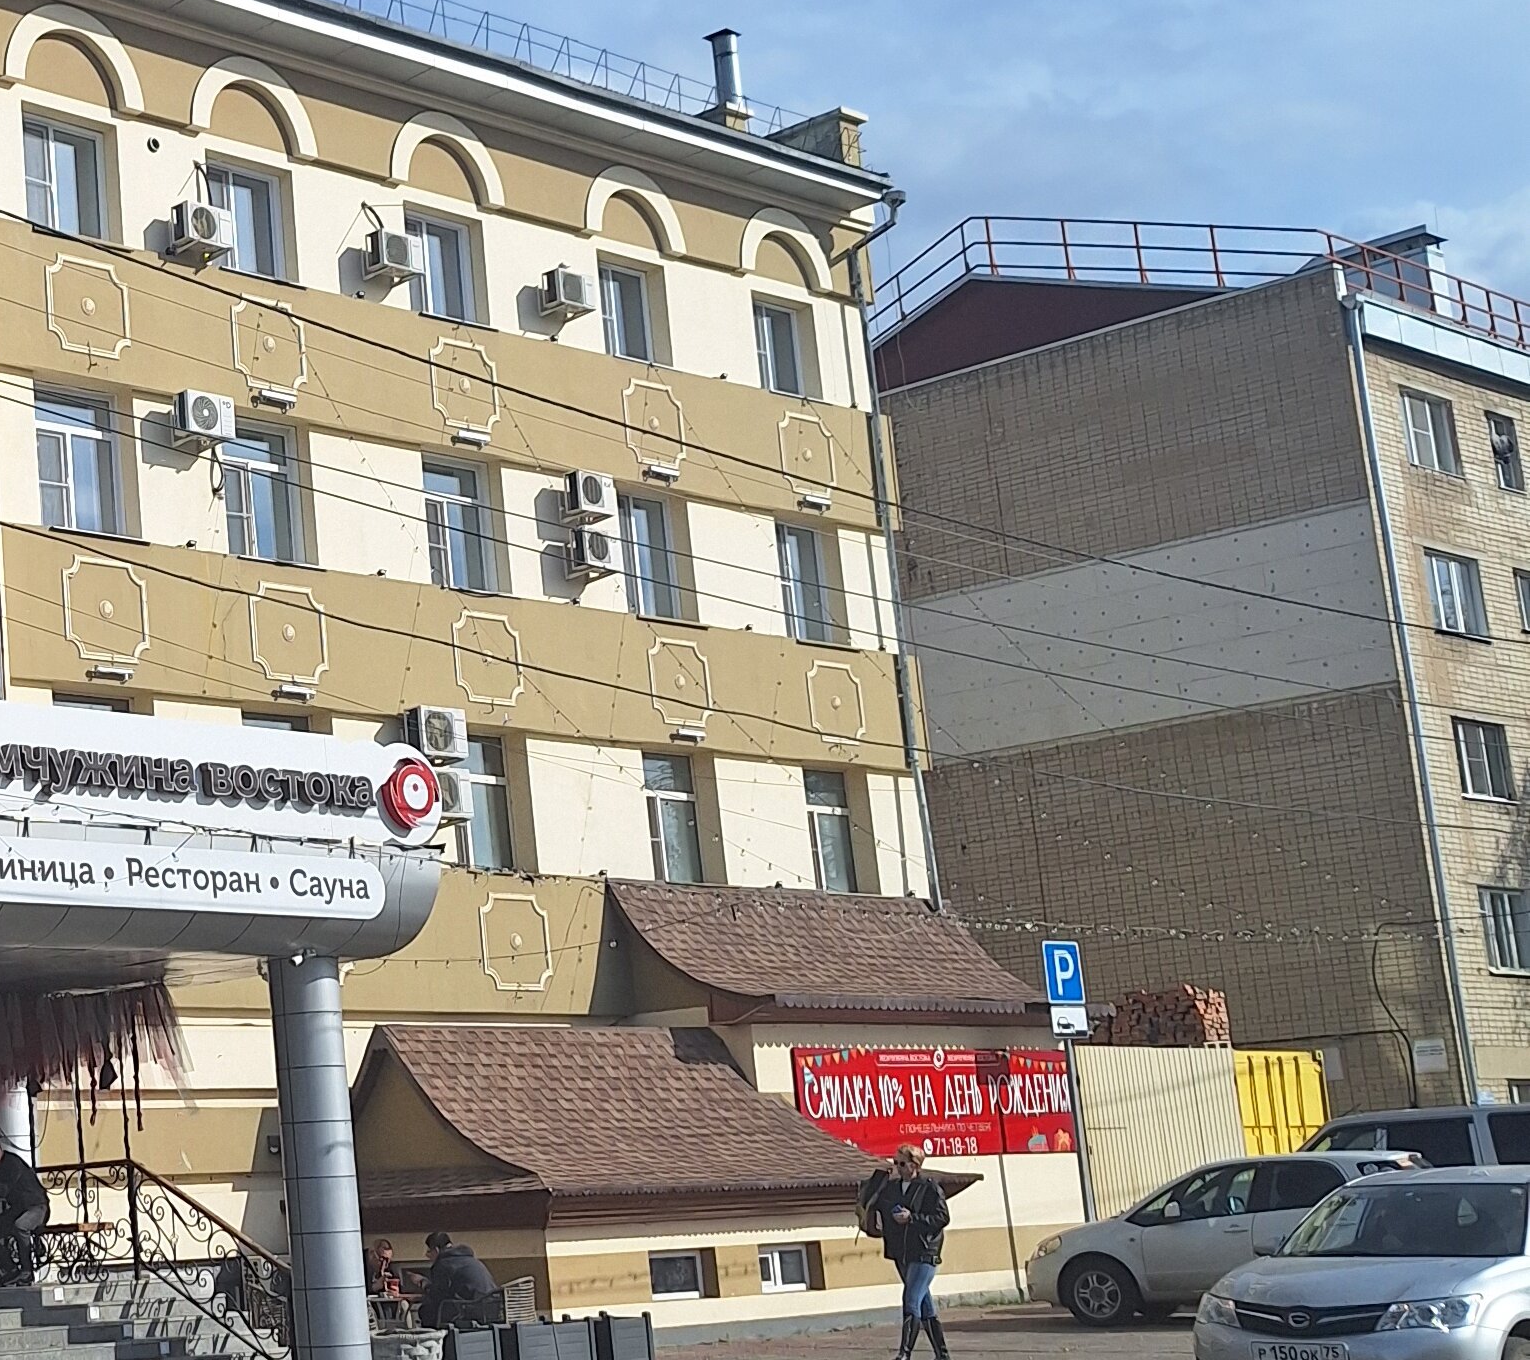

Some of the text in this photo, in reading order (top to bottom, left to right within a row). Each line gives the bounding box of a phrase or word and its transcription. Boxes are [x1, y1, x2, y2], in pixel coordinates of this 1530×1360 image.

[202, 761, 378, 811] востока
[125, 856, 262, 894] Ресторан
[288, 868, 371, 904] Сауна
[1053, 949, 1075, 997] P
[878, 1074, 906, 1118] 10%
[910, 1074, 938, 1117] НА
[944, 1074, 983, 1120] ДЕНЬ
[987, 1073, 1072, 1118] РОЖДЕНИЯ
[932, 1136, 979, 1155] 71-18-18
